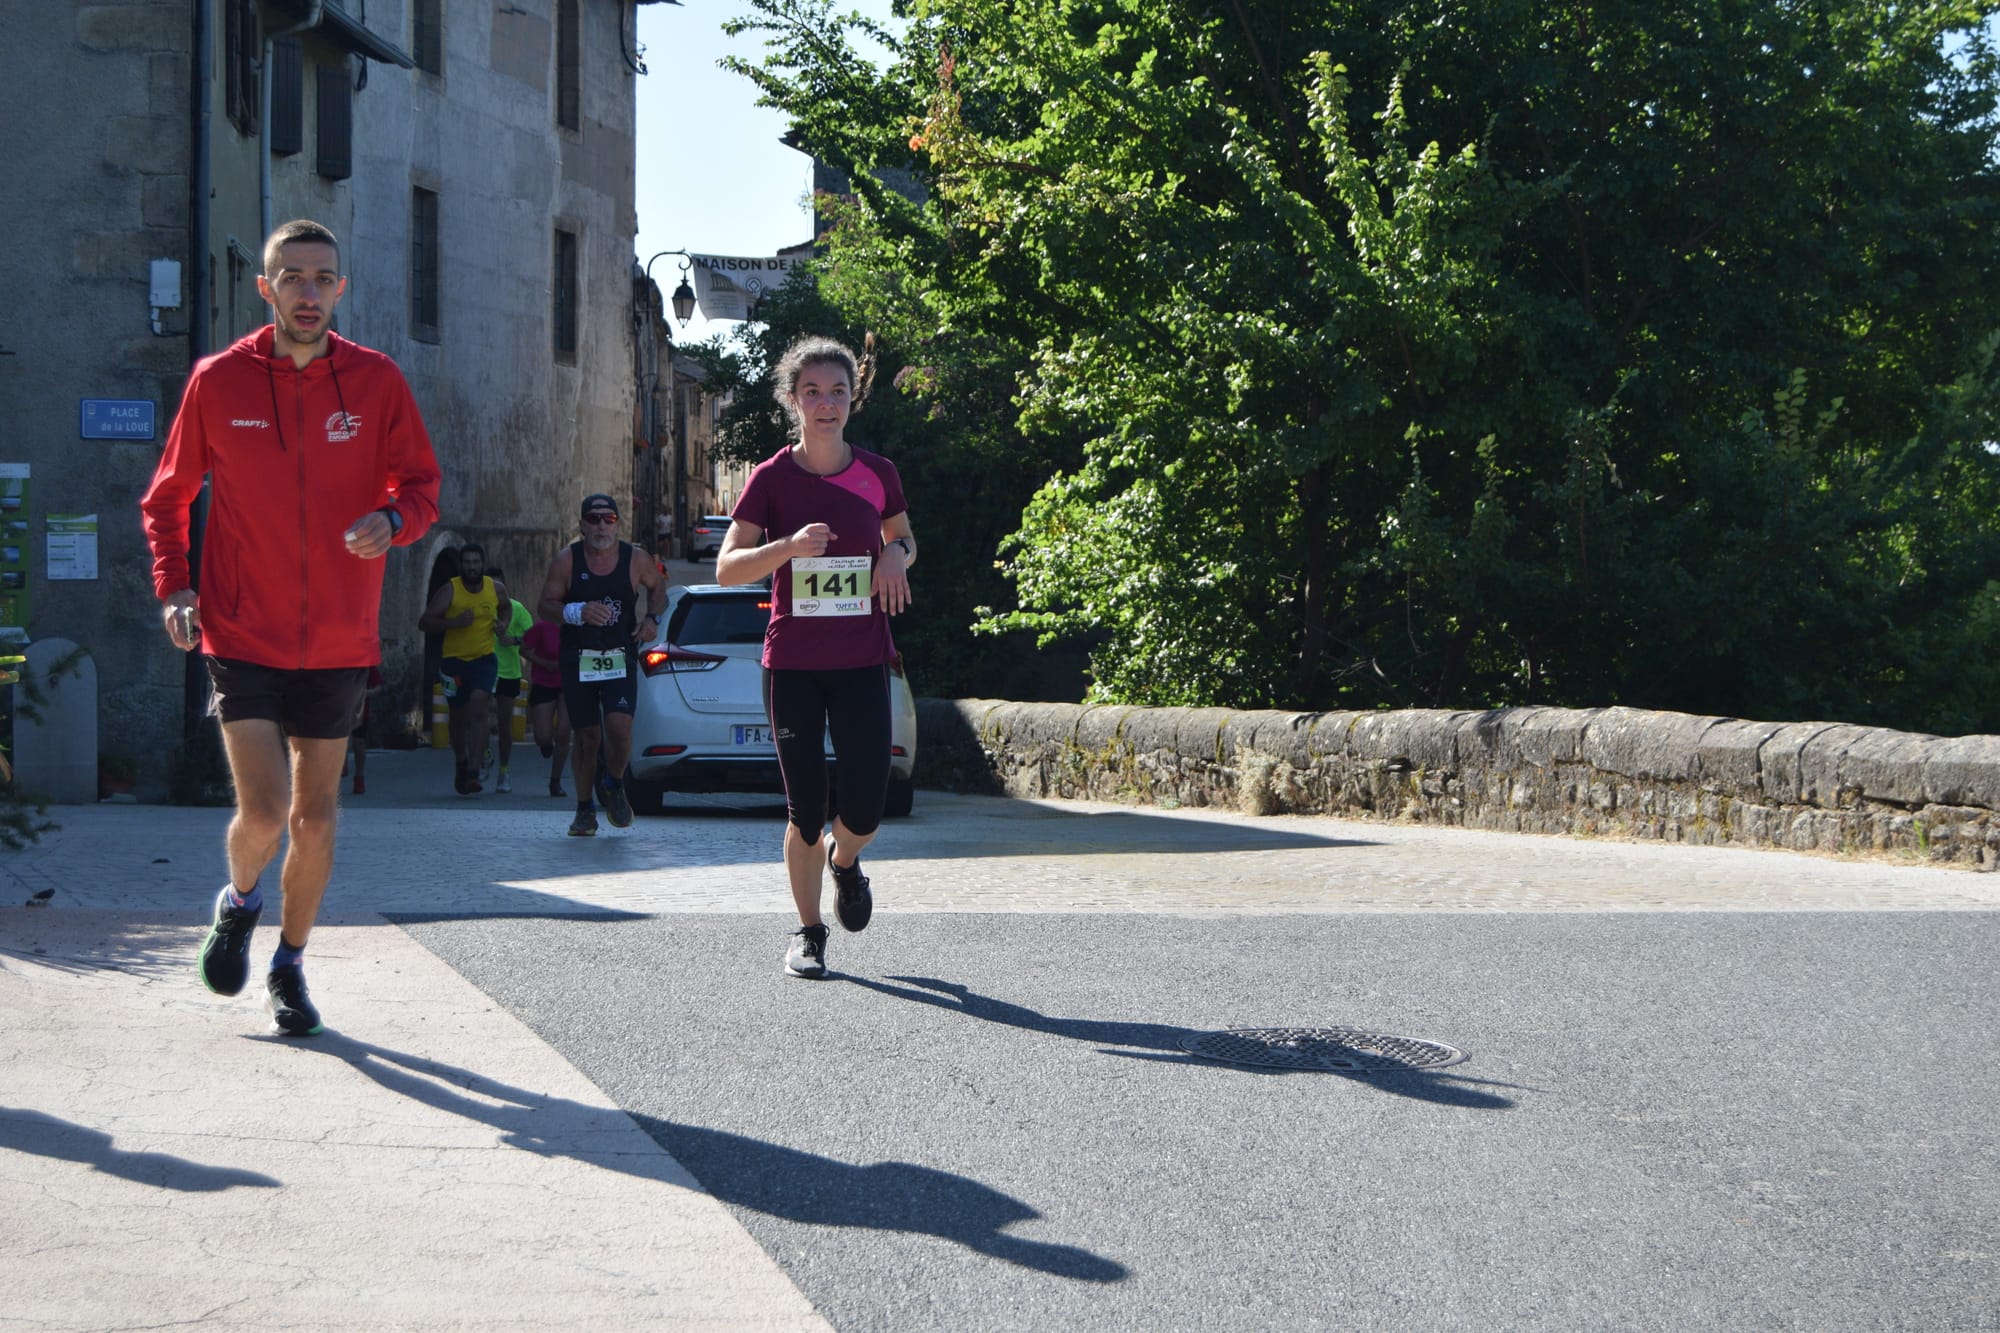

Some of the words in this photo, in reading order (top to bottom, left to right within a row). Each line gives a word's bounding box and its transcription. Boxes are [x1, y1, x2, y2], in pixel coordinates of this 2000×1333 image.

[696, 257, 761, 271] MAISON
[767, 259, 788, 271] DE
[111, 408, 139, 417] PLACE
[101, 422, 112, 432] de
[114, 422, 123, 432] la
[126, 422, 149, 432] LOUE
[232, 419, 260, 427] CRAFT
[805, 573, 857, 597] 141
[592, 657, 613, 671] 39
[745, 728, 773, 743] FA-4
